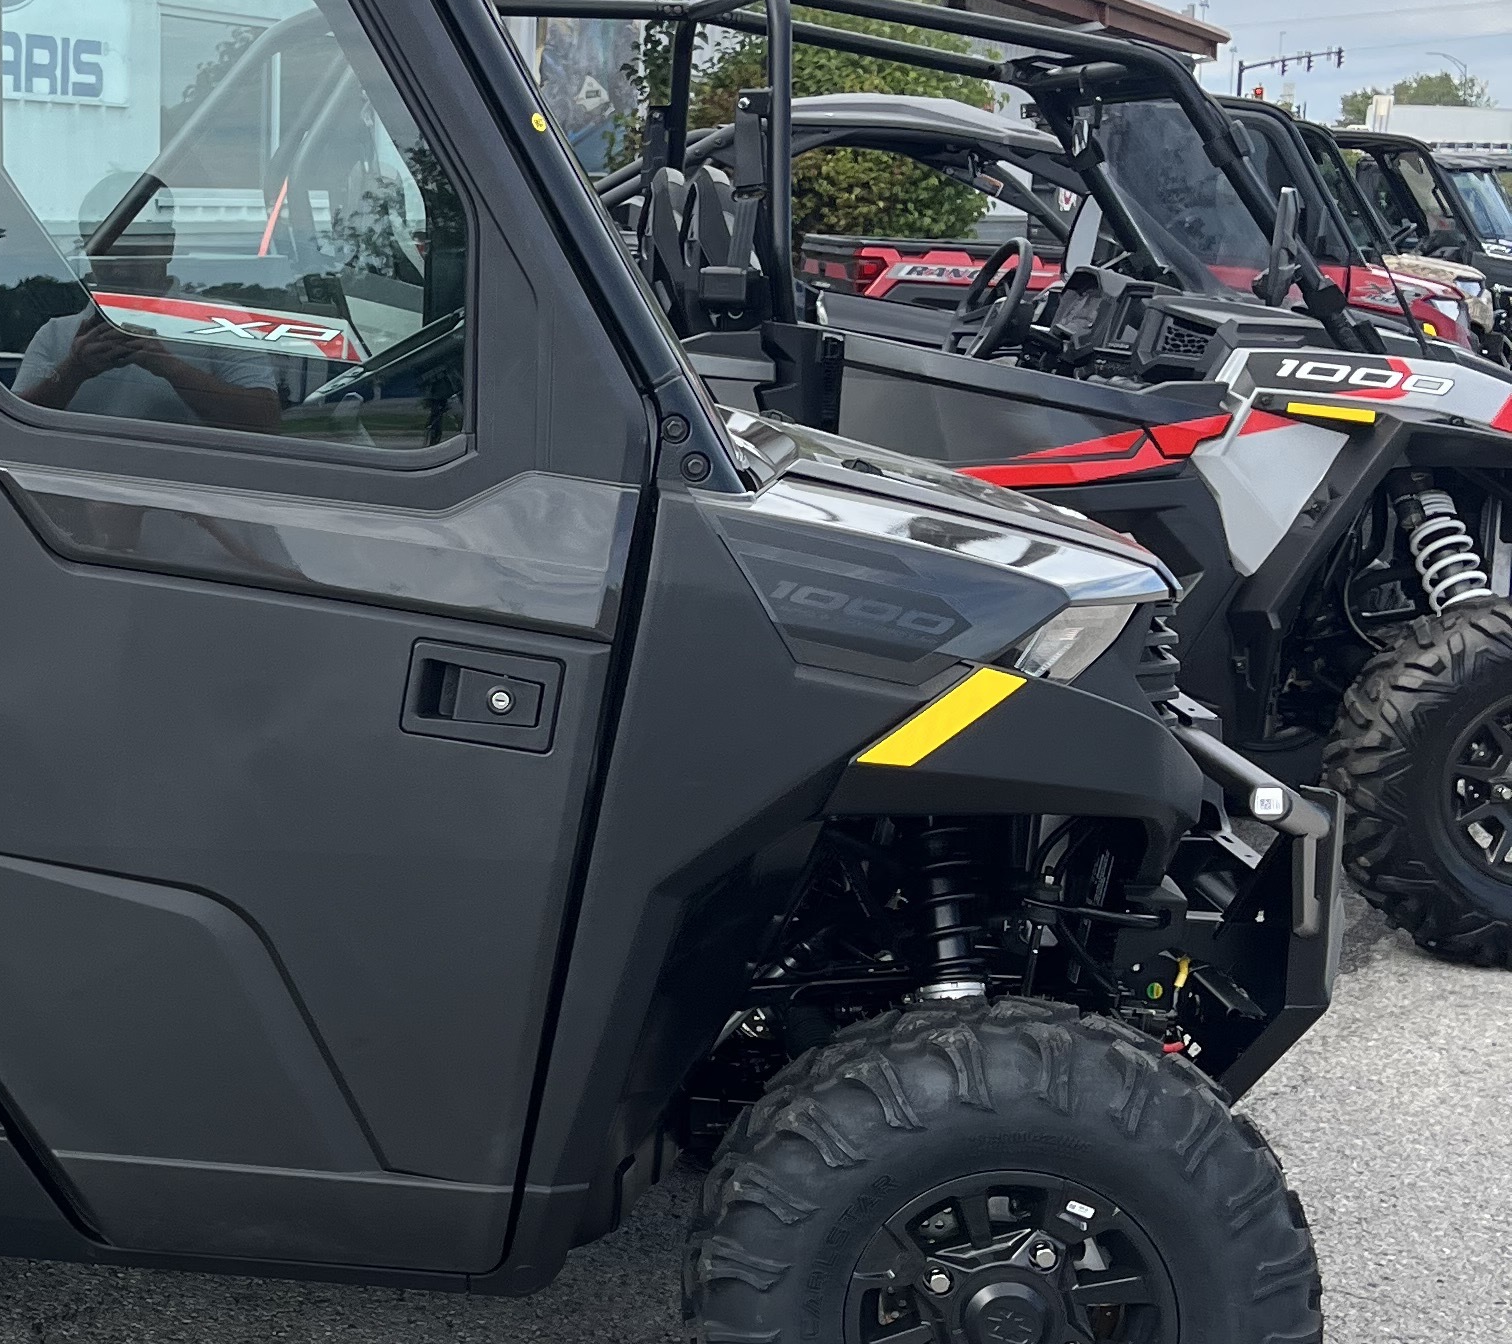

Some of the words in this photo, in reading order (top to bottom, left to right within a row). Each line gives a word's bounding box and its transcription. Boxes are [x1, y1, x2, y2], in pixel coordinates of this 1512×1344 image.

[188, 316, 343, 342] XP
[1274, 356, 1456, 397] 1000
[769, 580, 957, 636] 1000
[800, 1174, 902, 1340] CARLSTAR
